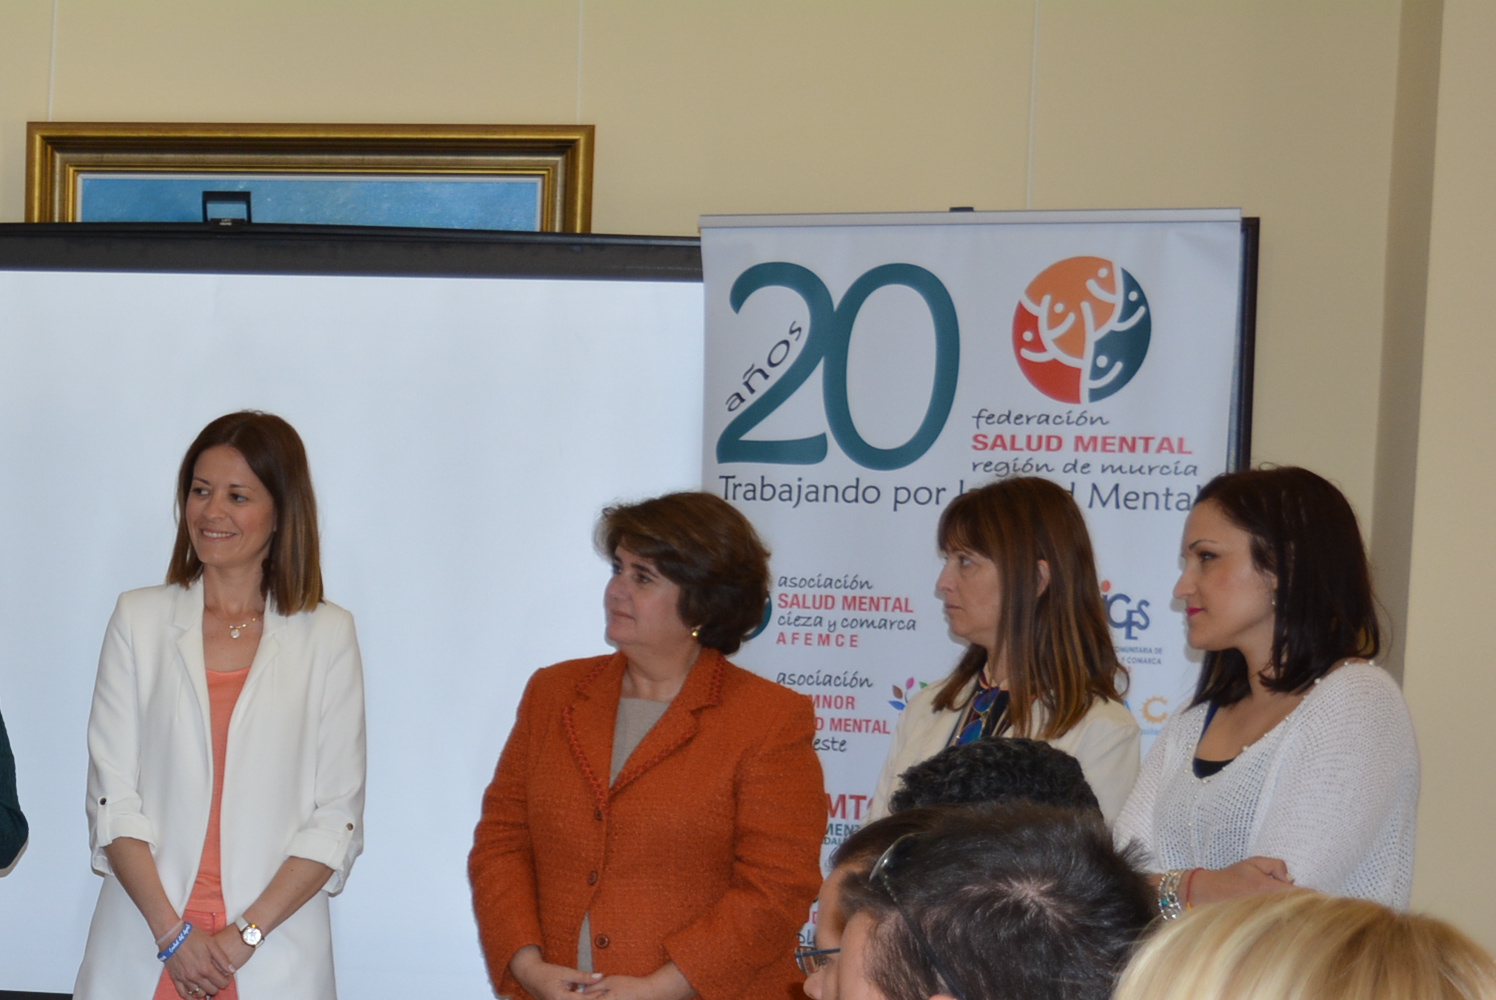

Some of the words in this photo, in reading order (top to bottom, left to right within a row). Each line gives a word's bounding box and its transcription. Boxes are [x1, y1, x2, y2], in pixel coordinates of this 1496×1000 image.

[715, 260, 961, 472] 20
[724, 319, 803, 413] años
[971, 408, 1110, 428] federación
[971, 433, 1063, 454] SALUD
[1074, 435, 1193, 455] MENTAL
[971, 457, 1055, 479] región
[1062, 456, 1092, 475] de
[1100, 459, 1199, 477] murcia
[719, 474, 880, 508] Trabajando
[892, 482, 946, 511] por
[777, 573, 873, 590] asociación
[777, 592, 836, 611] SALUD
[841, 595, 914, 614] MENTAL
[777, 611, 823, 628] cieza
[827, 618, 837, 633] y
[840, 616, 916, 631] comarca
[1114, 646, 1153, 655] OMUNITARIA
[776, 670, 873, 688] asociación
[808, 694, 855, 710] MNOR
[829, 717, 890, 735] MENTAL
[813, 737, 847, 753] este
